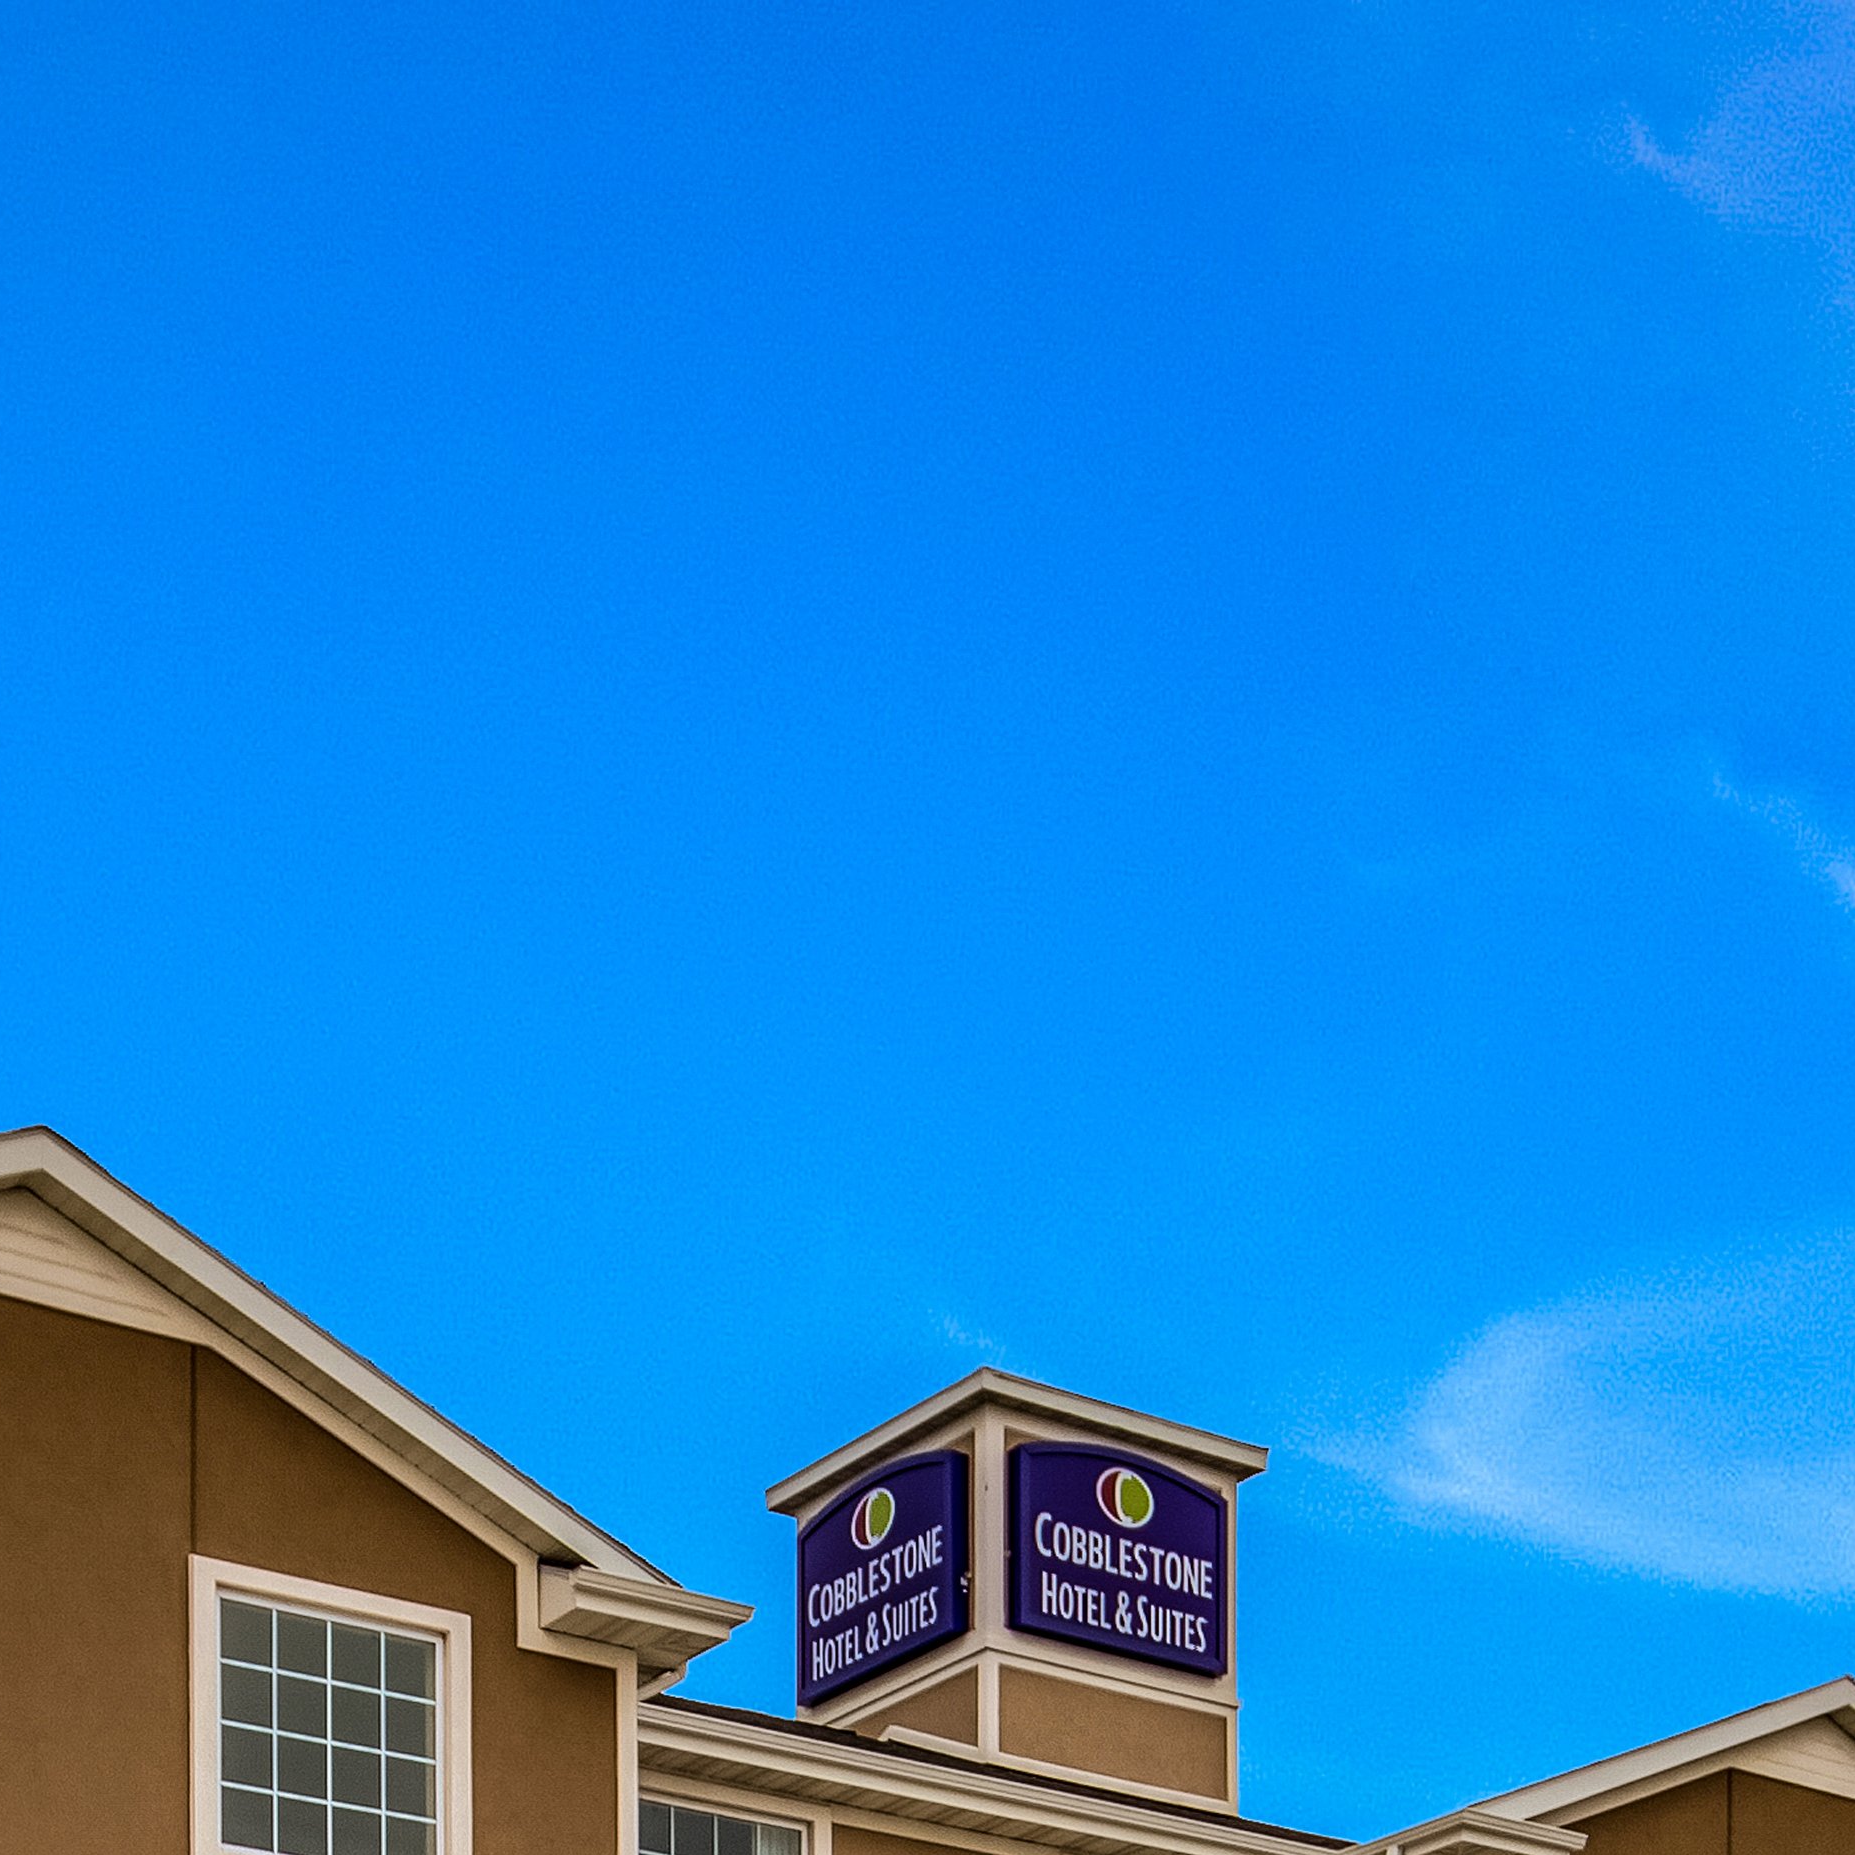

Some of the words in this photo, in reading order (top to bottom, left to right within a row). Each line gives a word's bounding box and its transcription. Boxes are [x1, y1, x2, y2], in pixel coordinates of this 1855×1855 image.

[808, 1525, 943, 1627] COBBLESTONE
[1035, 1512, 1213, 1600] COBBLESTONE
[812, 1625, 863, 1681] HOTEL
[865, 1611, 879, 1654] &
[882, 1586, 939, 1646] SUITES
[1042, 1570, 1112, 1630] HOTEL
[1115, 1590, 1133, 1635] &
[1137, 1595, 1208, 1652] SUITES
